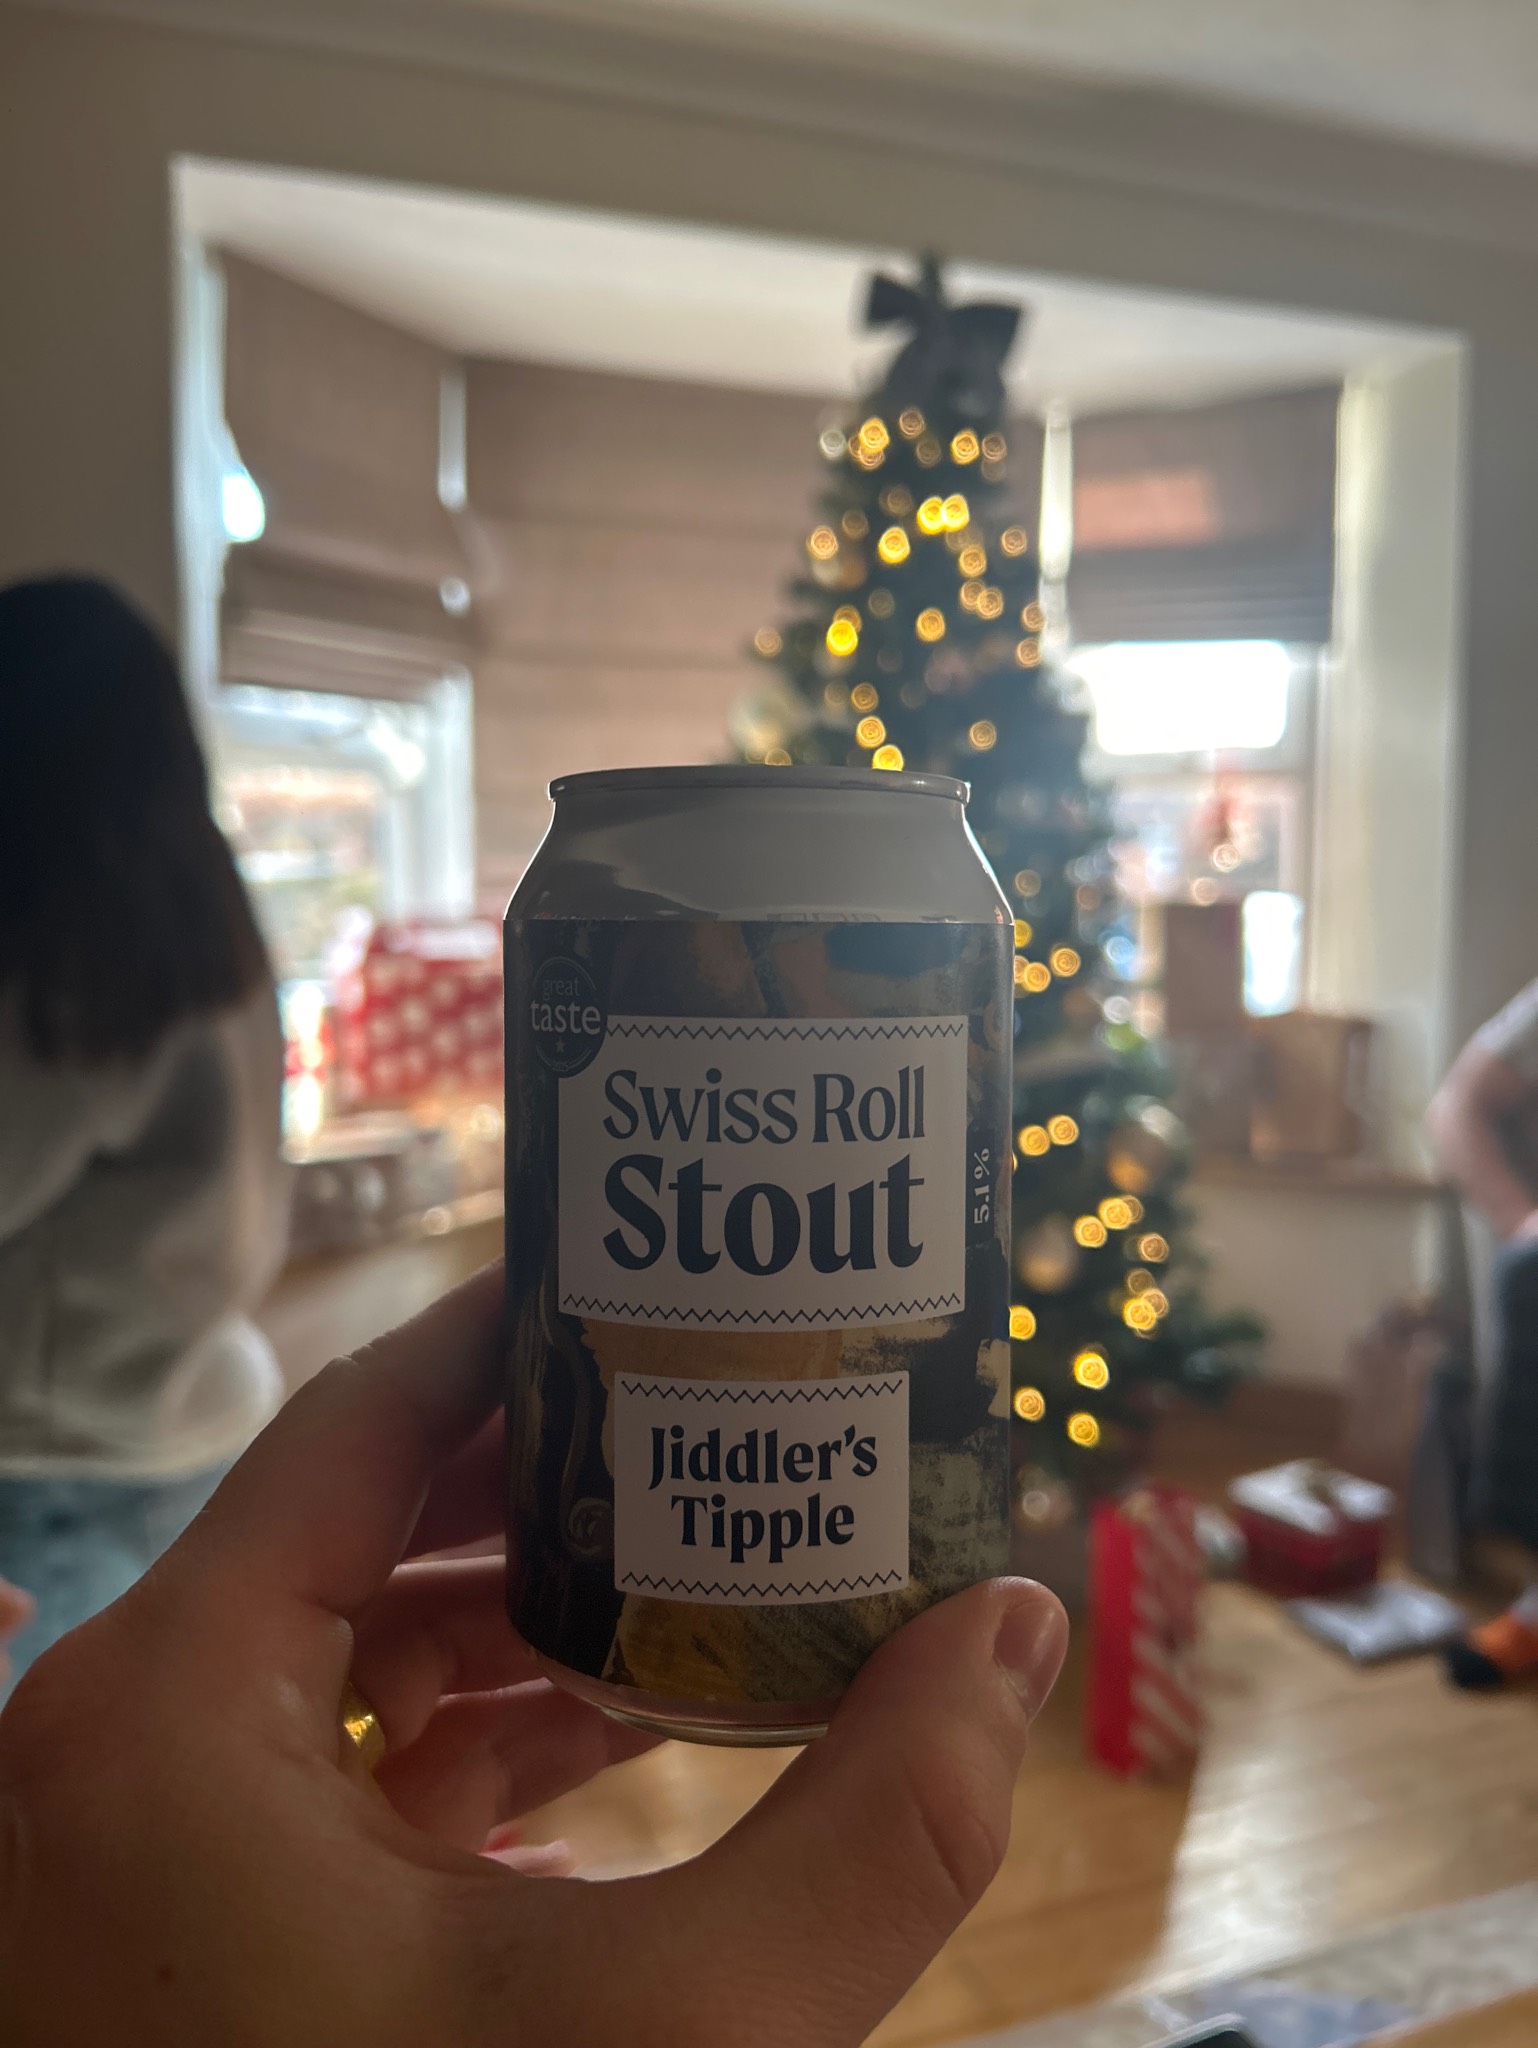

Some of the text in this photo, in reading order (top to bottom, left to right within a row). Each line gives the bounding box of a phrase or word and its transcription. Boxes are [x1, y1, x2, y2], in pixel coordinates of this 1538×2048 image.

[530, 1000, 600, 1035] taste
[542, 977, 580, 1000] great
[603, 1066, 925, 1144] Swiss Roll
[603, 1153, 925, 1276] Stout
[974, 1148, 990, 1224] 5.1%
[648, 1424, 878, 1491] Jiddler’s
[671, 1492, 855, 1564] Tipple
